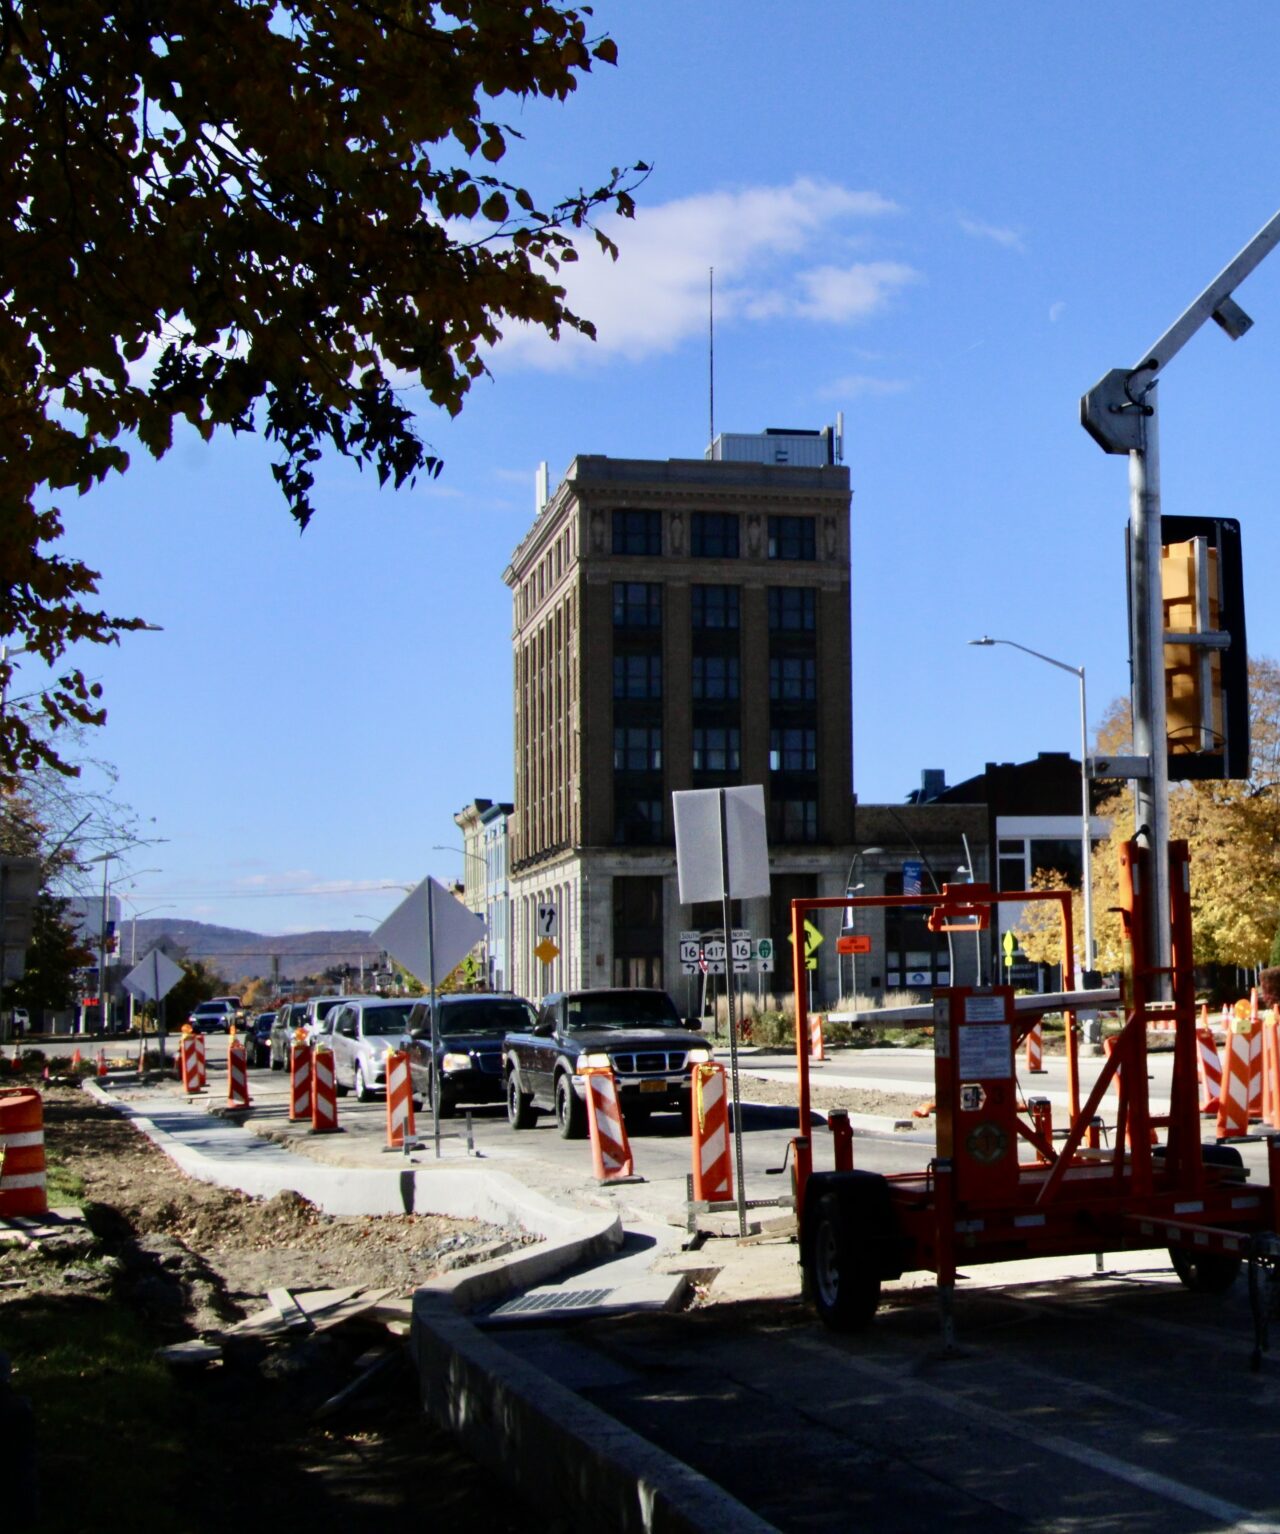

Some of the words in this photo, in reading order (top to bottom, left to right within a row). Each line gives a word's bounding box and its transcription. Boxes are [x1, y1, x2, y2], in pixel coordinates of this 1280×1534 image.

[732, 931, 751, 939] NORTH
[684, 946, 697, 958] 16
[706, 946, 725, 957] 417
[736, 944, 748, 956] 16
